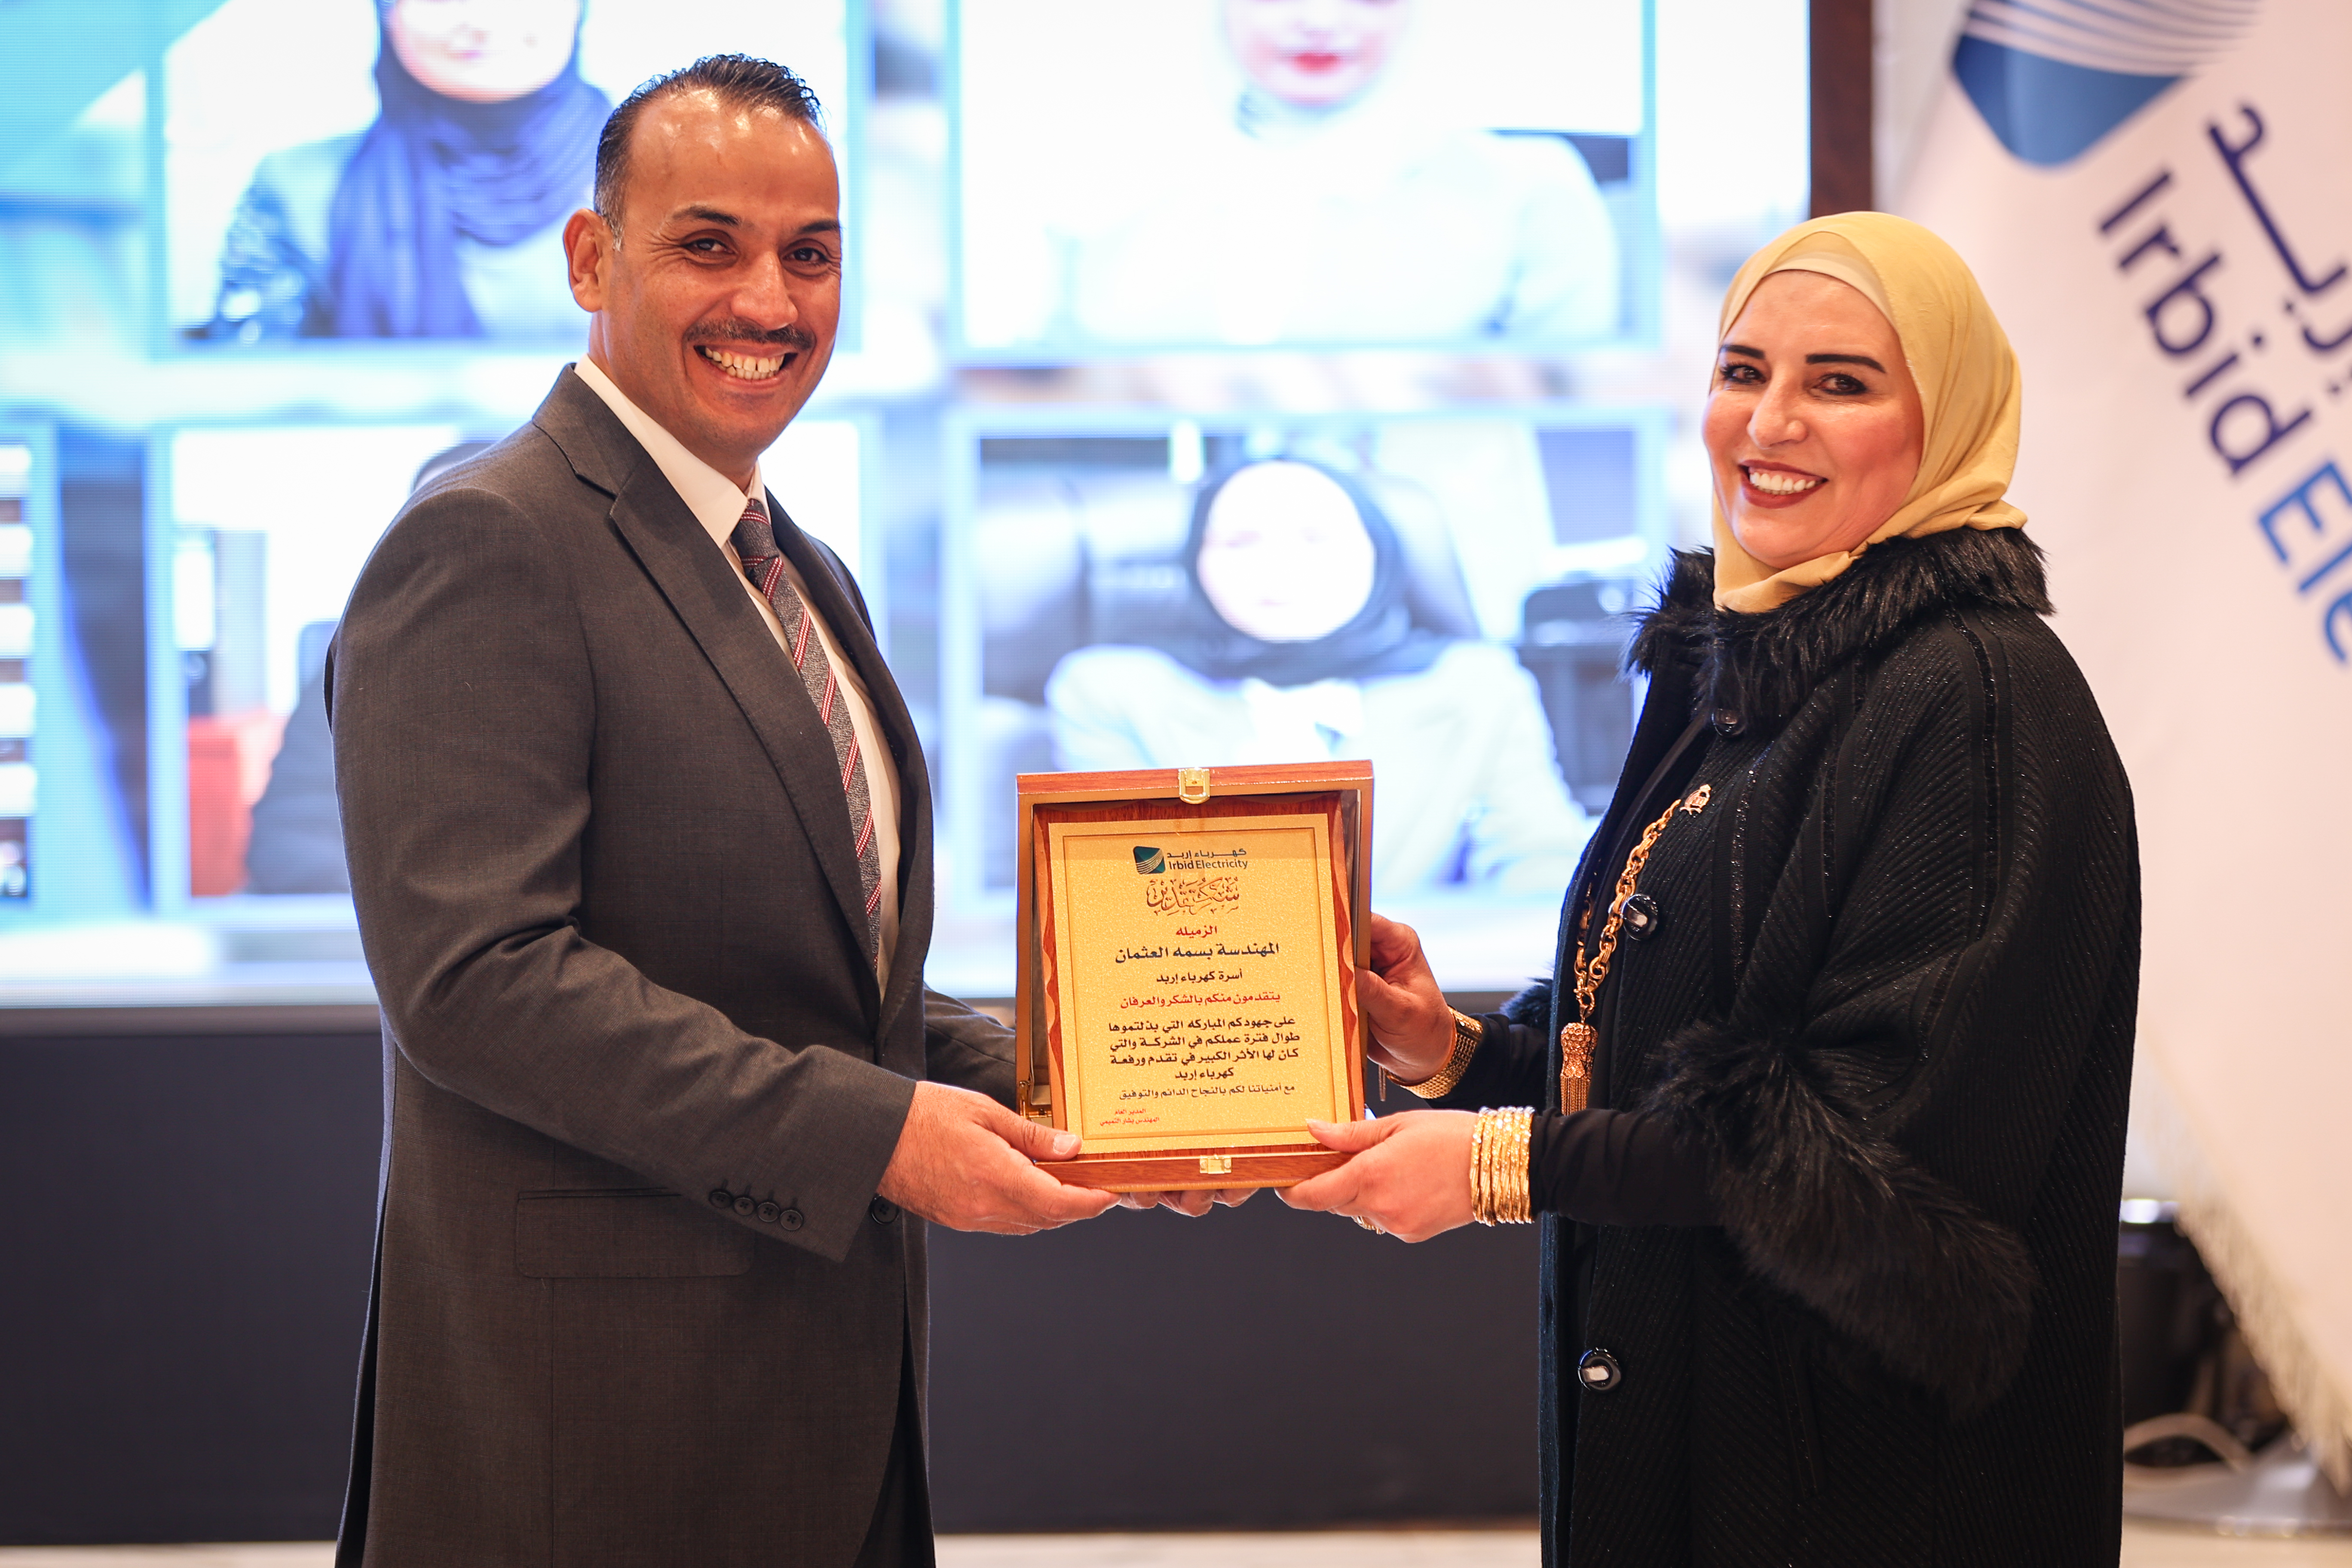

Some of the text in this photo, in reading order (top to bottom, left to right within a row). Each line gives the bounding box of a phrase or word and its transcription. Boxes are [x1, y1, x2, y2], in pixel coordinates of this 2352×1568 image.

[2204, 105, 2352, 395] ربد
[2097, 168, 2316, 476] Irbid
[1167, 848, 1247, 859] كهرباء إربد
[1168, 859, 1248, 870] Irbid Electricity
[1176, 925, 1217, 938] الزميله
[1115, 942, 1279, 964] المهندسة بسمه العثمان
[1156, 968, 1243, 985] أسرة كهرباء إربد
[1120, 991, 1280, 1009] يتقدمون منكم بالشكر والعرفان
[1109, 1016, 1295, 1034] على جهودكم المباركه التي بذلتموها
[1110, 1032, 1300, 1052] طوال فترة عملكم في الشركة والتي
[1110, 1047, 1298, 1066] كان لها الأثر الكبير في تقدم ورفعة
[1175, 1067, 1234, 1080] كهرباء إربد
[1119, 1082, 1295, 1100] مع أمنياتنا لكم بالنجاح الدائم والتوفيق
